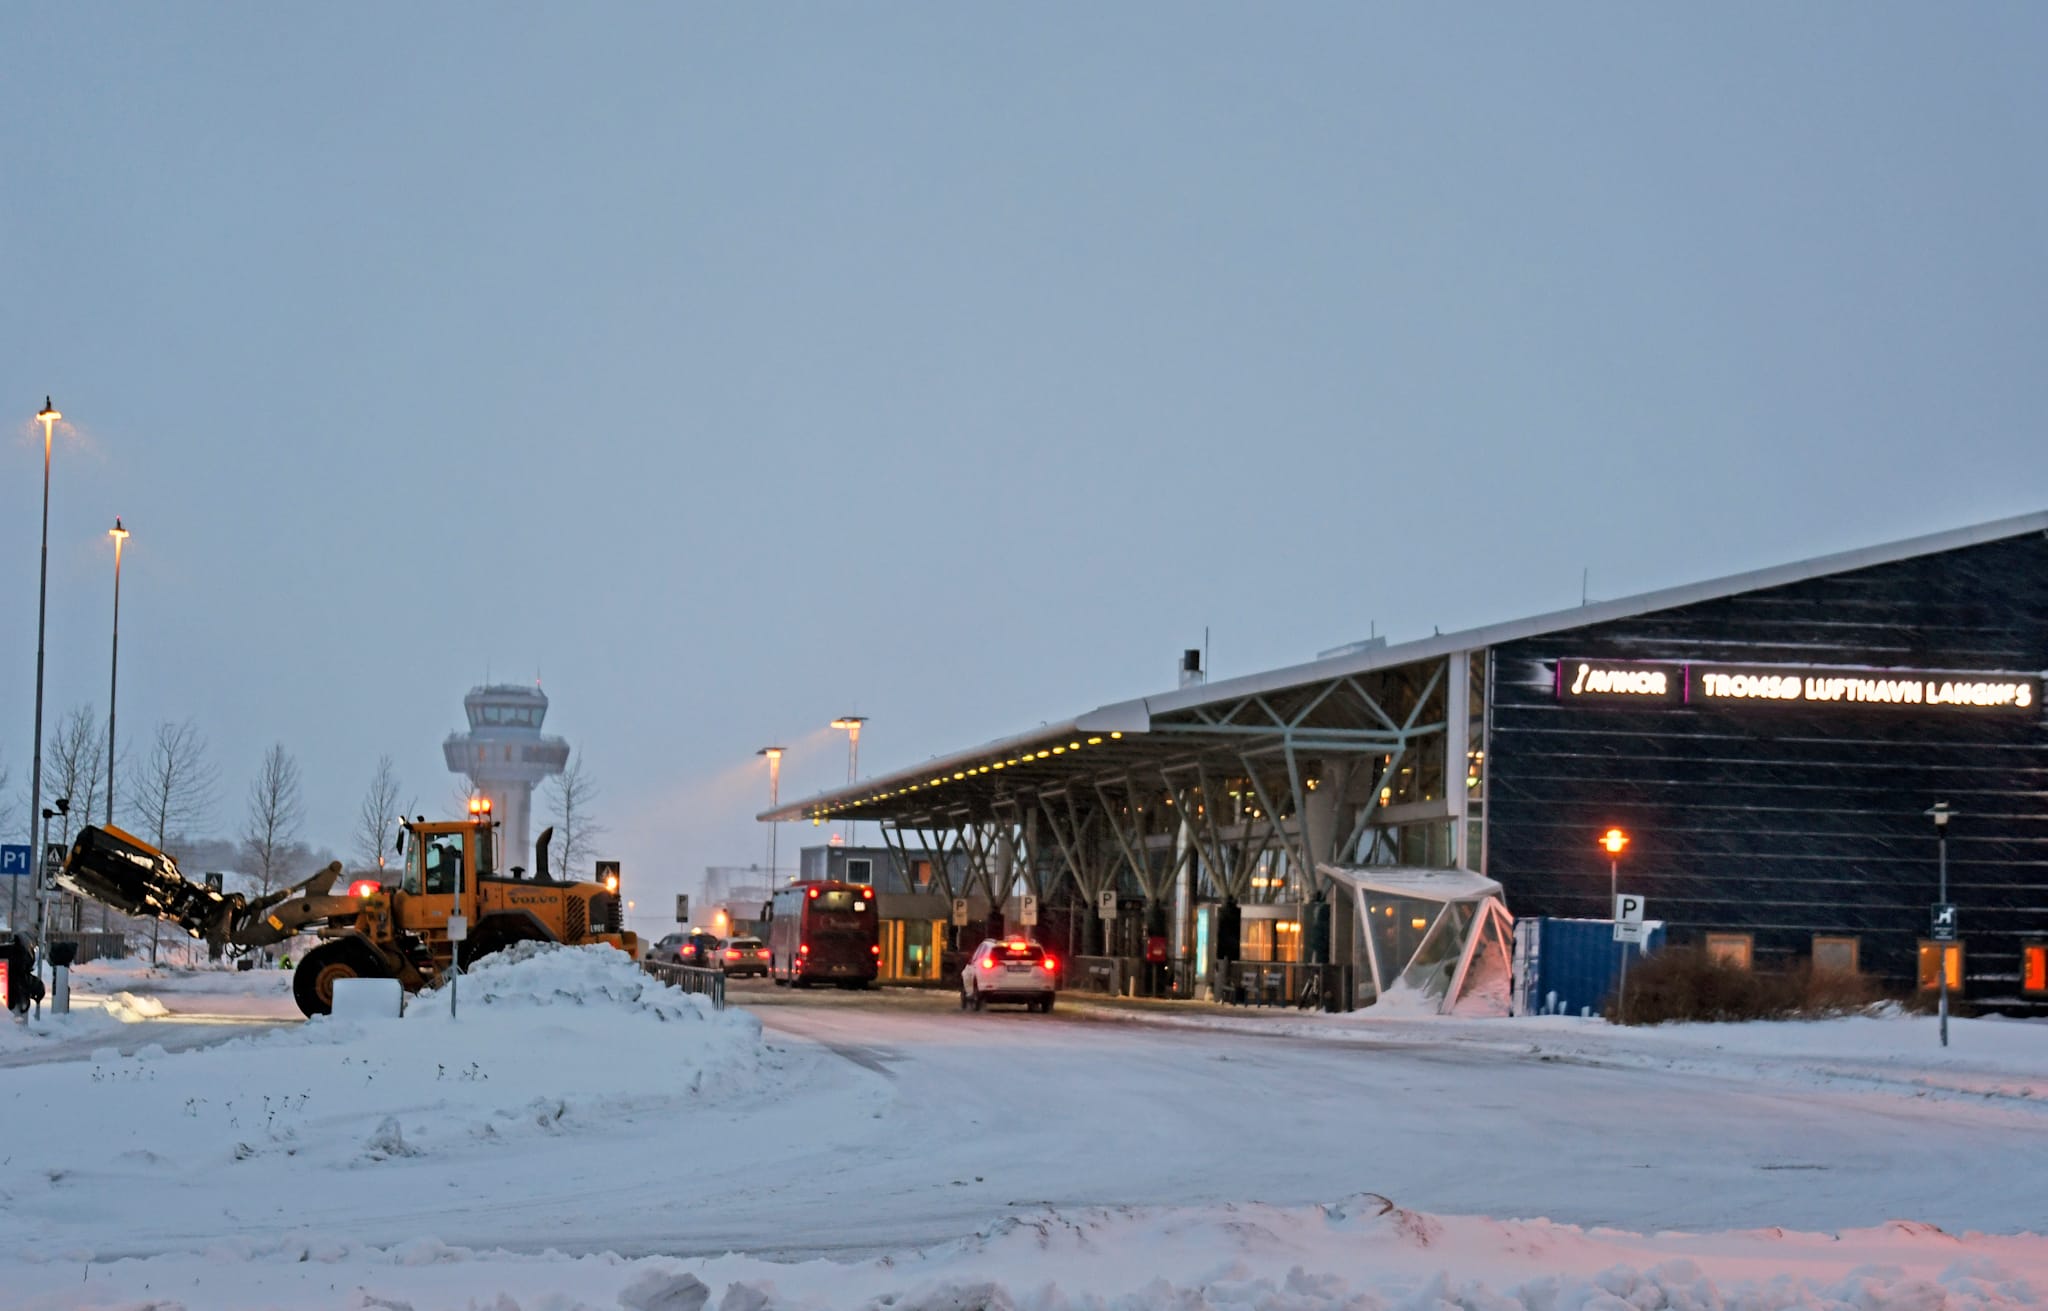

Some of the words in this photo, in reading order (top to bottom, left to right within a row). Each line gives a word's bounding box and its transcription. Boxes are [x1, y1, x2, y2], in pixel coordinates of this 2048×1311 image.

[1585, 670, 1667, 695] AVINOR
[1702, 674, 1802, 700] TROMSØ
[1805, 677, 1922, 703] LUFTHAVN
[4, 851, 26, 869] P1
[511, 896, 557, 904] VOLVO
[956, 901, 964, 910] P
[1024, 897, 1033, 908] P
[1103, 893, 1112, 906] P
[1622, 898, 1637, 919] P
